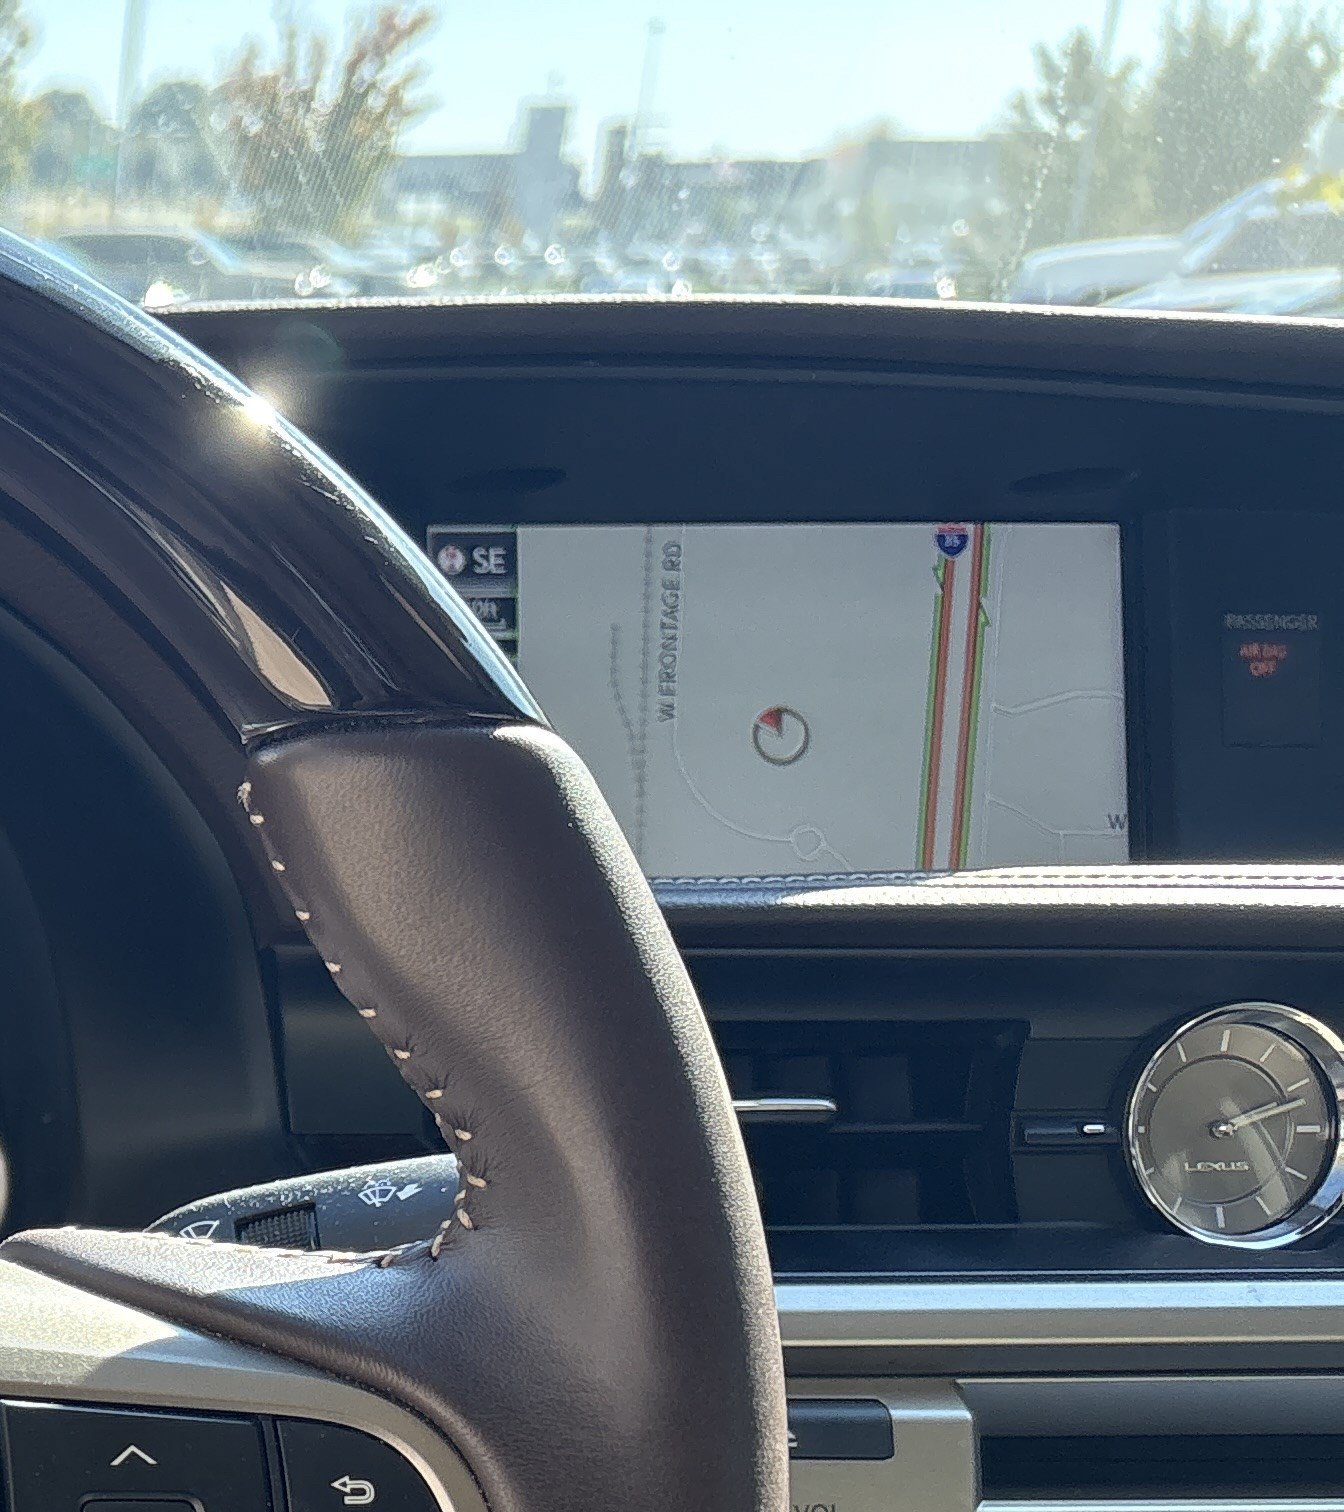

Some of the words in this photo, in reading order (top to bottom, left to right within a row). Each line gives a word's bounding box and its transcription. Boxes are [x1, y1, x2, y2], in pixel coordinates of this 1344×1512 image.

[472, 547, 508, 574] SE
[661, 541, 681, 571] RD
[657, 579, 681, 696] FRONTAGE
[657, 698, 676, 722] W
[1184, 1161, 1249, 1173] LEXUS
